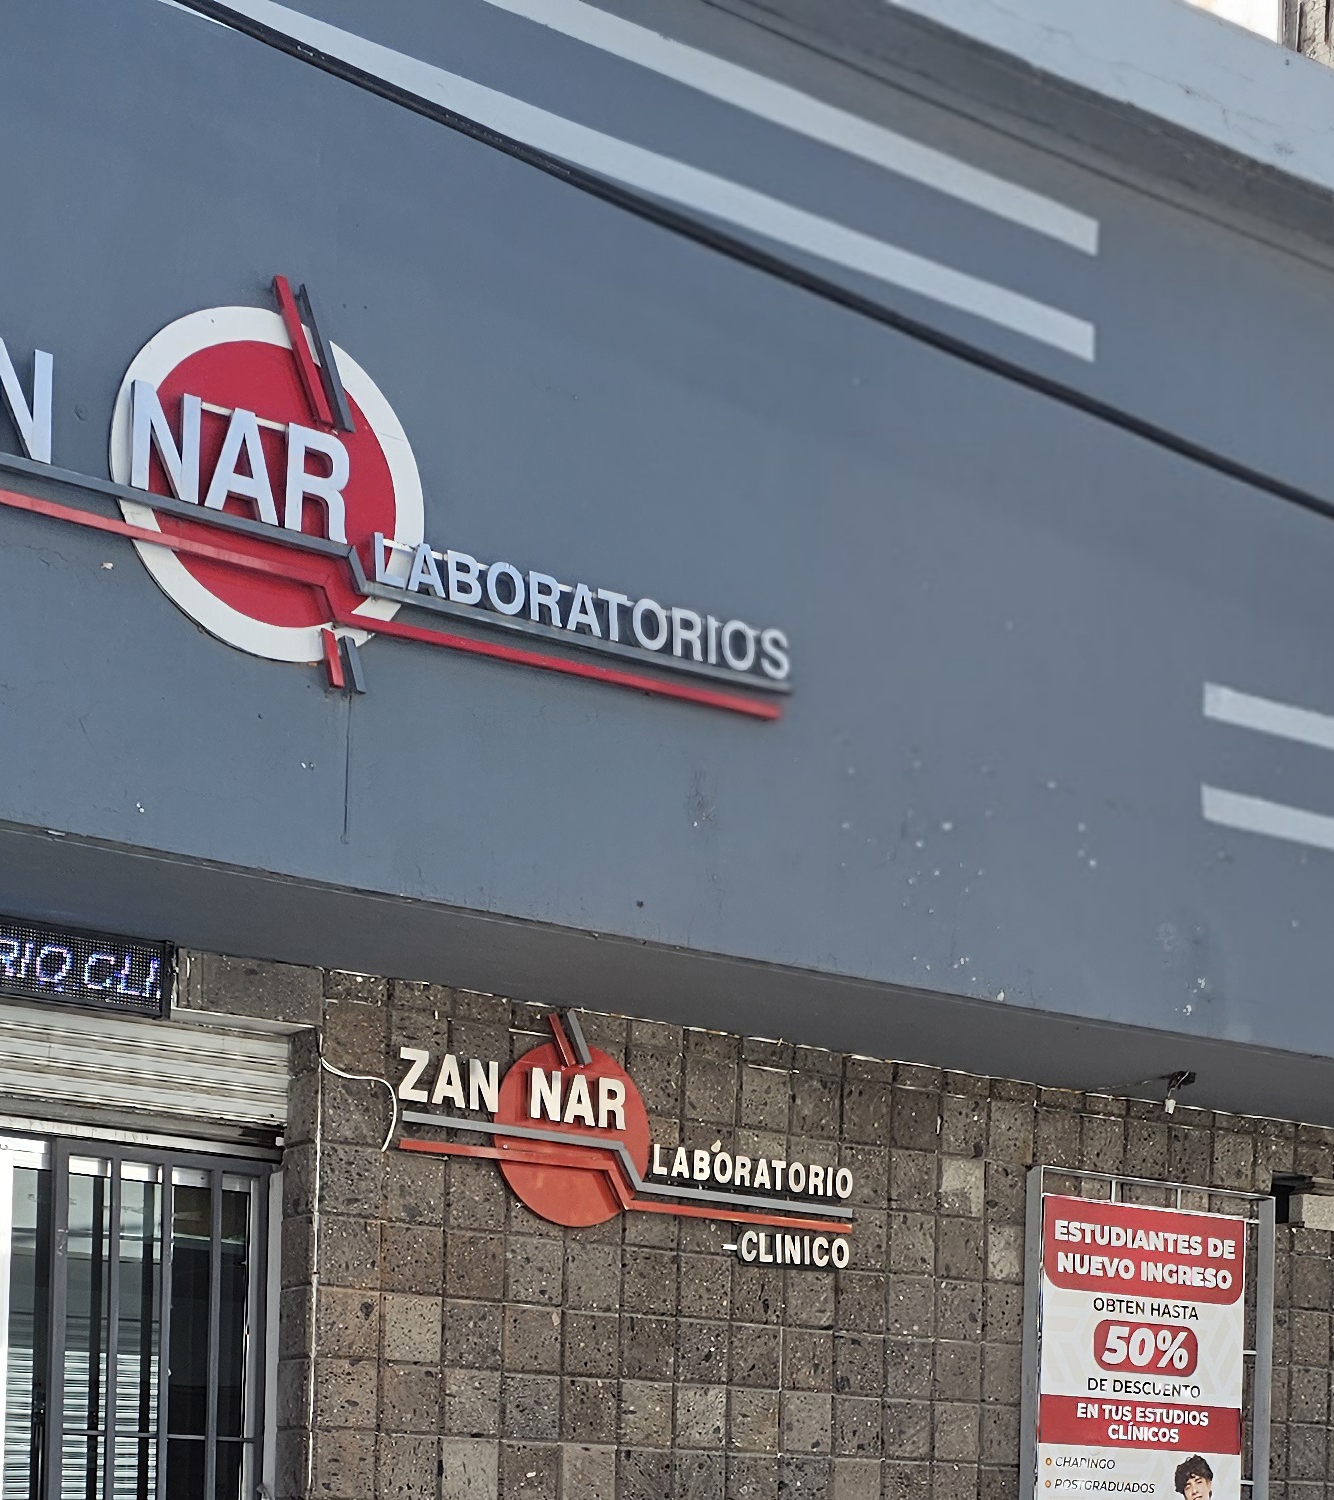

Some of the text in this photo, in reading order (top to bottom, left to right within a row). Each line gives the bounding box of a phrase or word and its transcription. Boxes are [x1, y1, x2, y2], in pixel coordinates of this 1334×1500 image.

[130, 380, 351, 543] NAR
[372, 531, 790, 680] LABORATORIOS
[398, 1046, 627, 1131] ZAN NAR
[652, 1143, 854, 1199] LABORATORIO
[740, 1230, 850, 1269] CLINICO
[1054, 1219, 1236, 1260] ESTUDIANTES DE
[1057, 1252, 1232, 1290] NUEVO INGRESO
[1093, 1297, 1199, 1320] OBTEN HASTA
[1101, 1325, 1189, 1370] 50%
[1087, 1377, 1201, 1398] DE DESCUENTO
[1076, 1402, 1209, 1427] EN TUS ESTUDIOS
[1108, 1421, 1179, 1443] CLÍNICOS
[1054, 1478, 1156, 1493] POSTGRADUADOS
